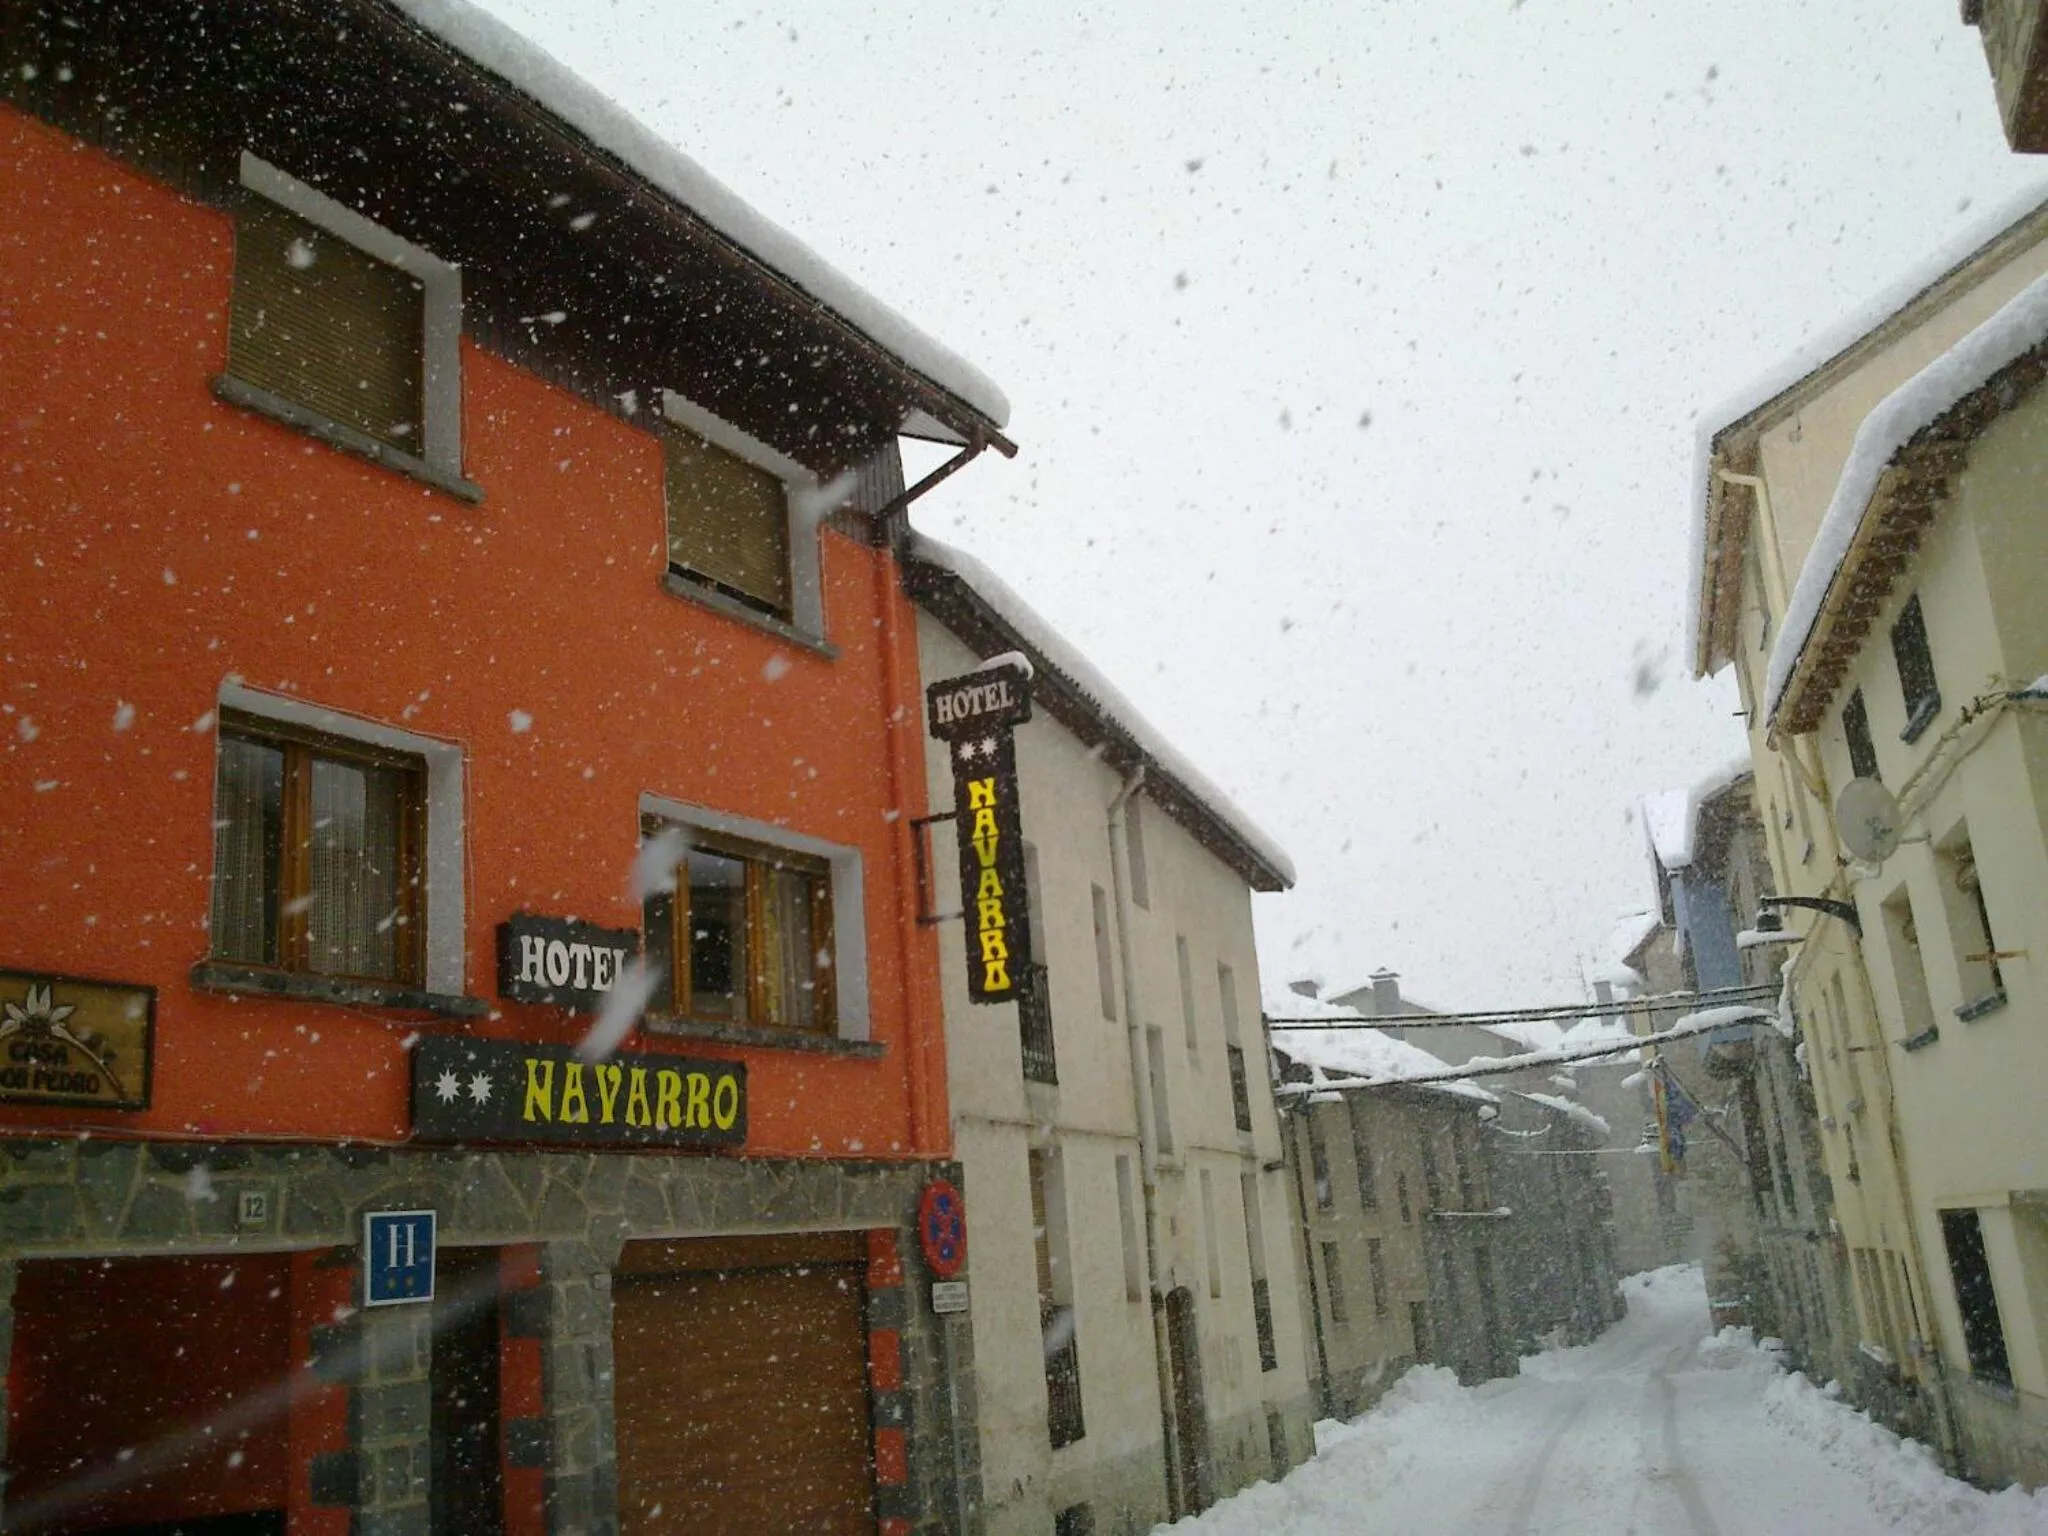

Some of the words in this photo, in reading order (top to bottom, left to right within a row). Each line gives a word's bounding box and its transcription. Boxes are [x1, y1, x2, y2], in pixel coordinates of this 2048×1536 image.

[936, 681, 1014, 724] HOTEL
[968, 777, 1011, 992] NAVARRO
[523, 1058, 739, 1130] NAVARRO
[245, 1195, 263, 1218] 12
[387, 1224, 417, 1268] H
